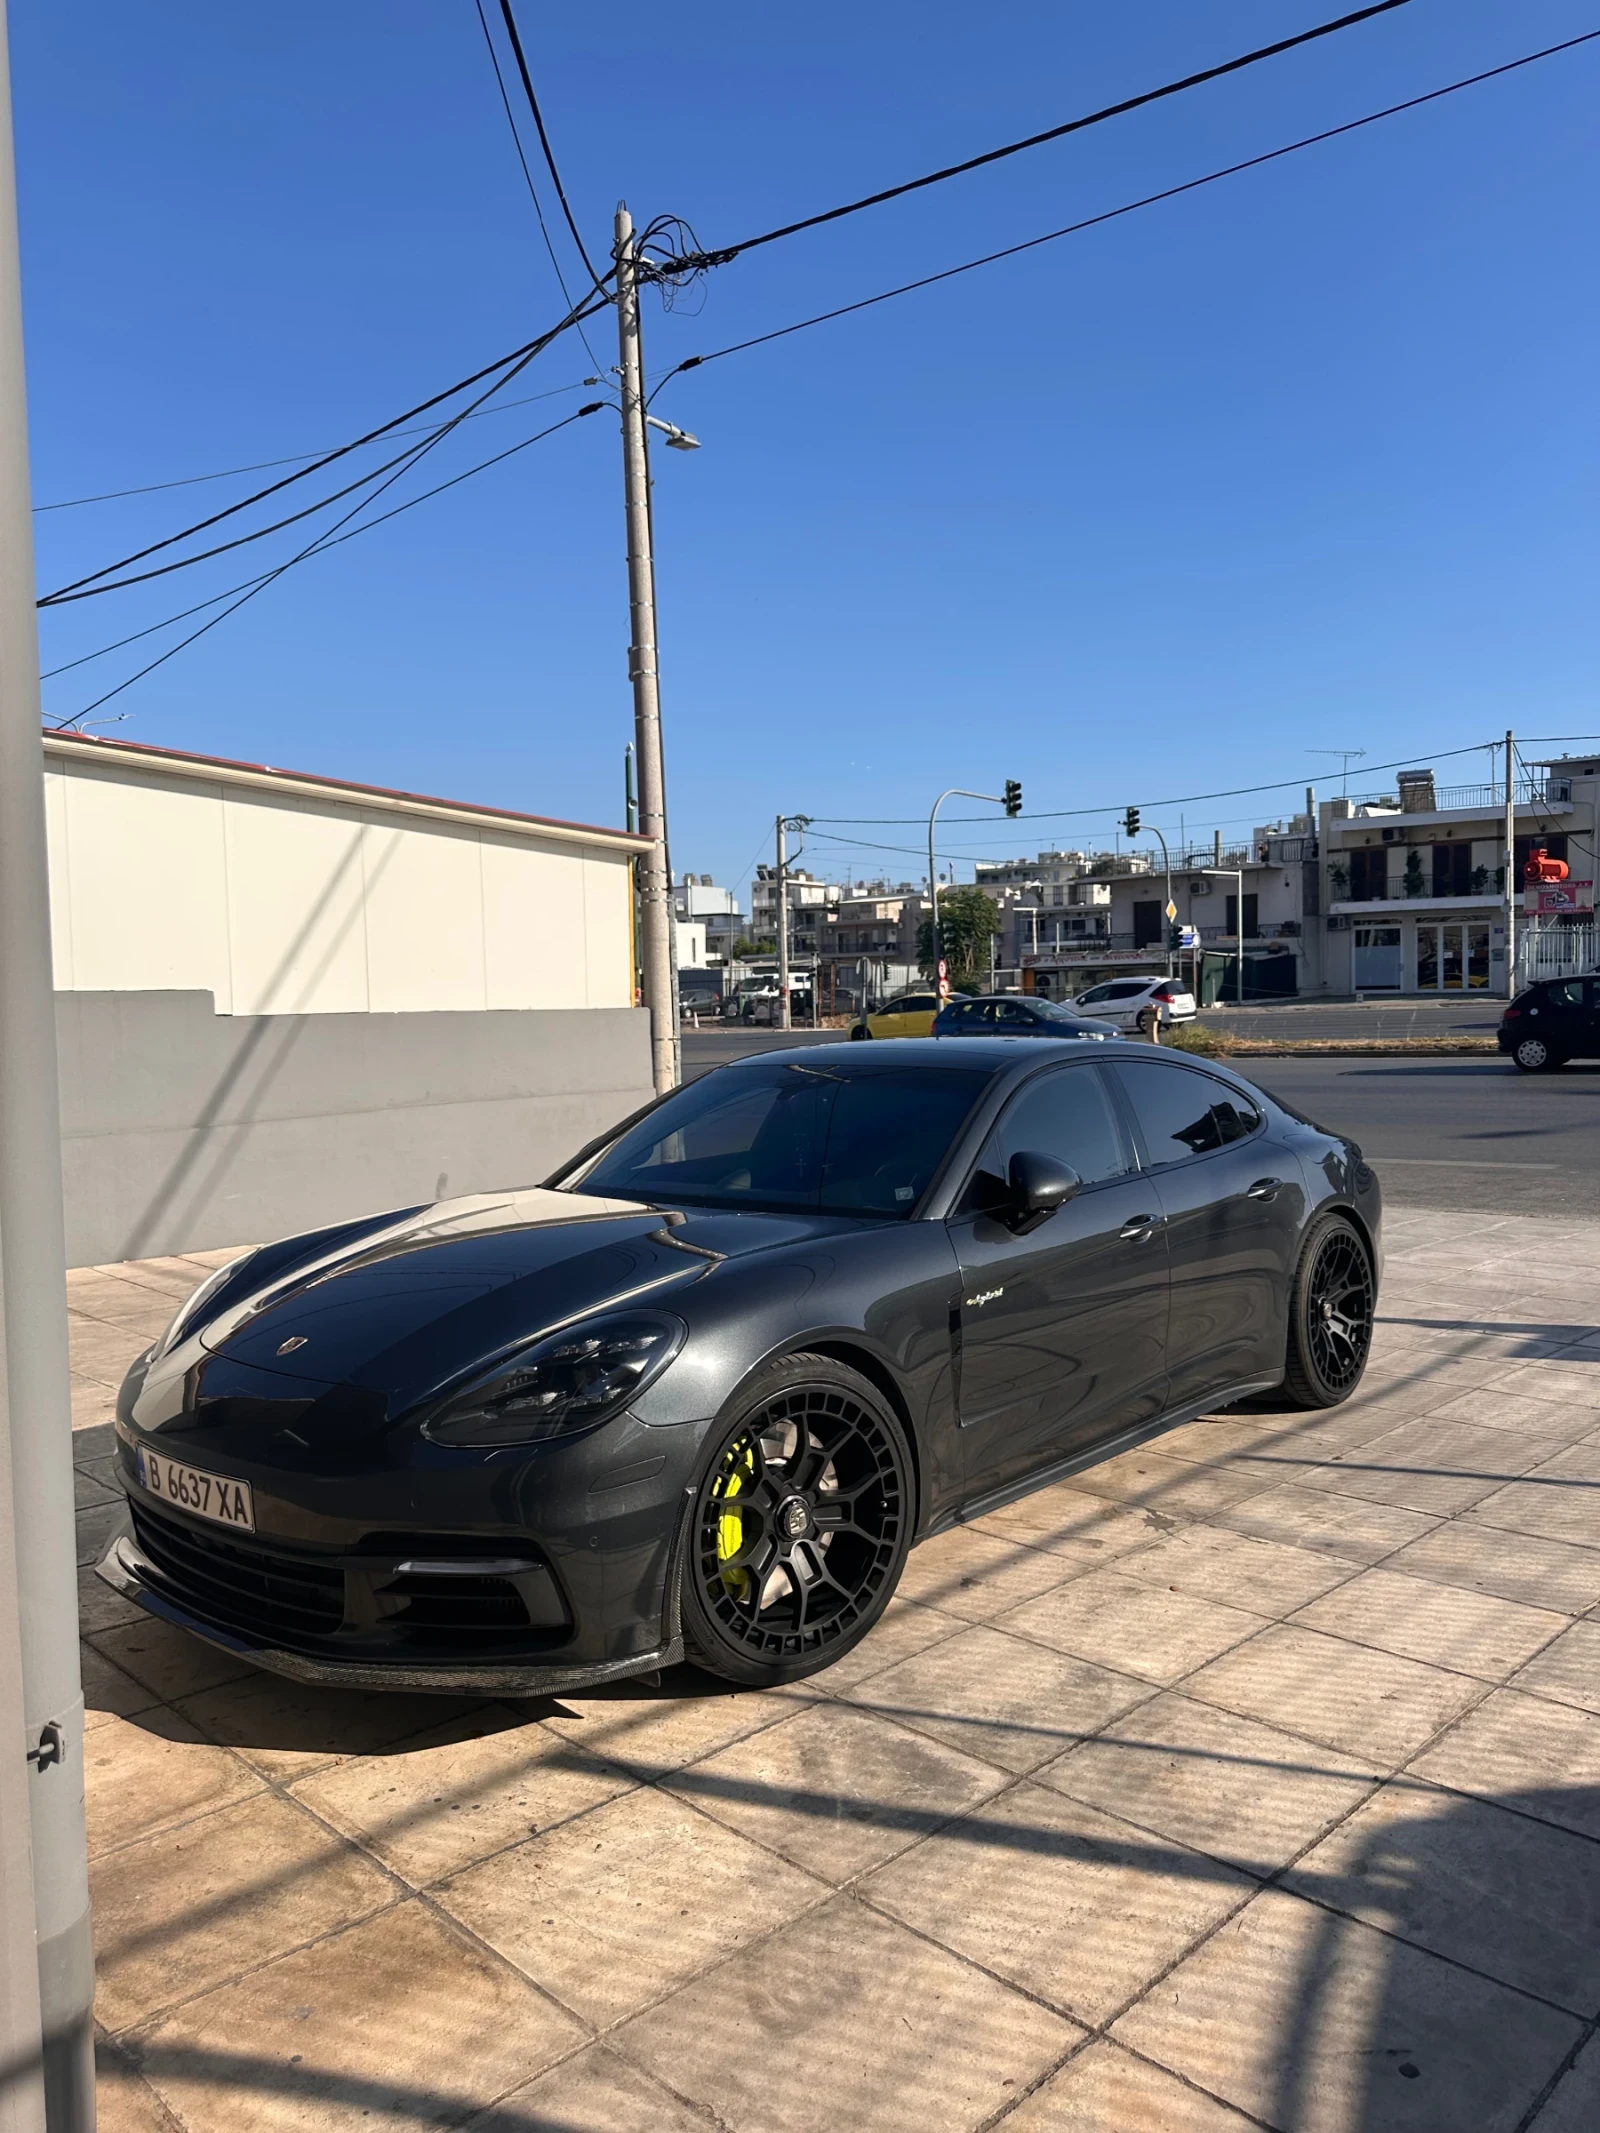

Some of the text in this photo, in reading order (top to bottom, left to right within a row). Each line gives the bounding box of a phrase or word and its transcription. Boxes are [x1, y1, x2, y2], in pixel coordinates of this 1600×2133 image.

[149, 1455, 248, 1523] B 6637 XA
